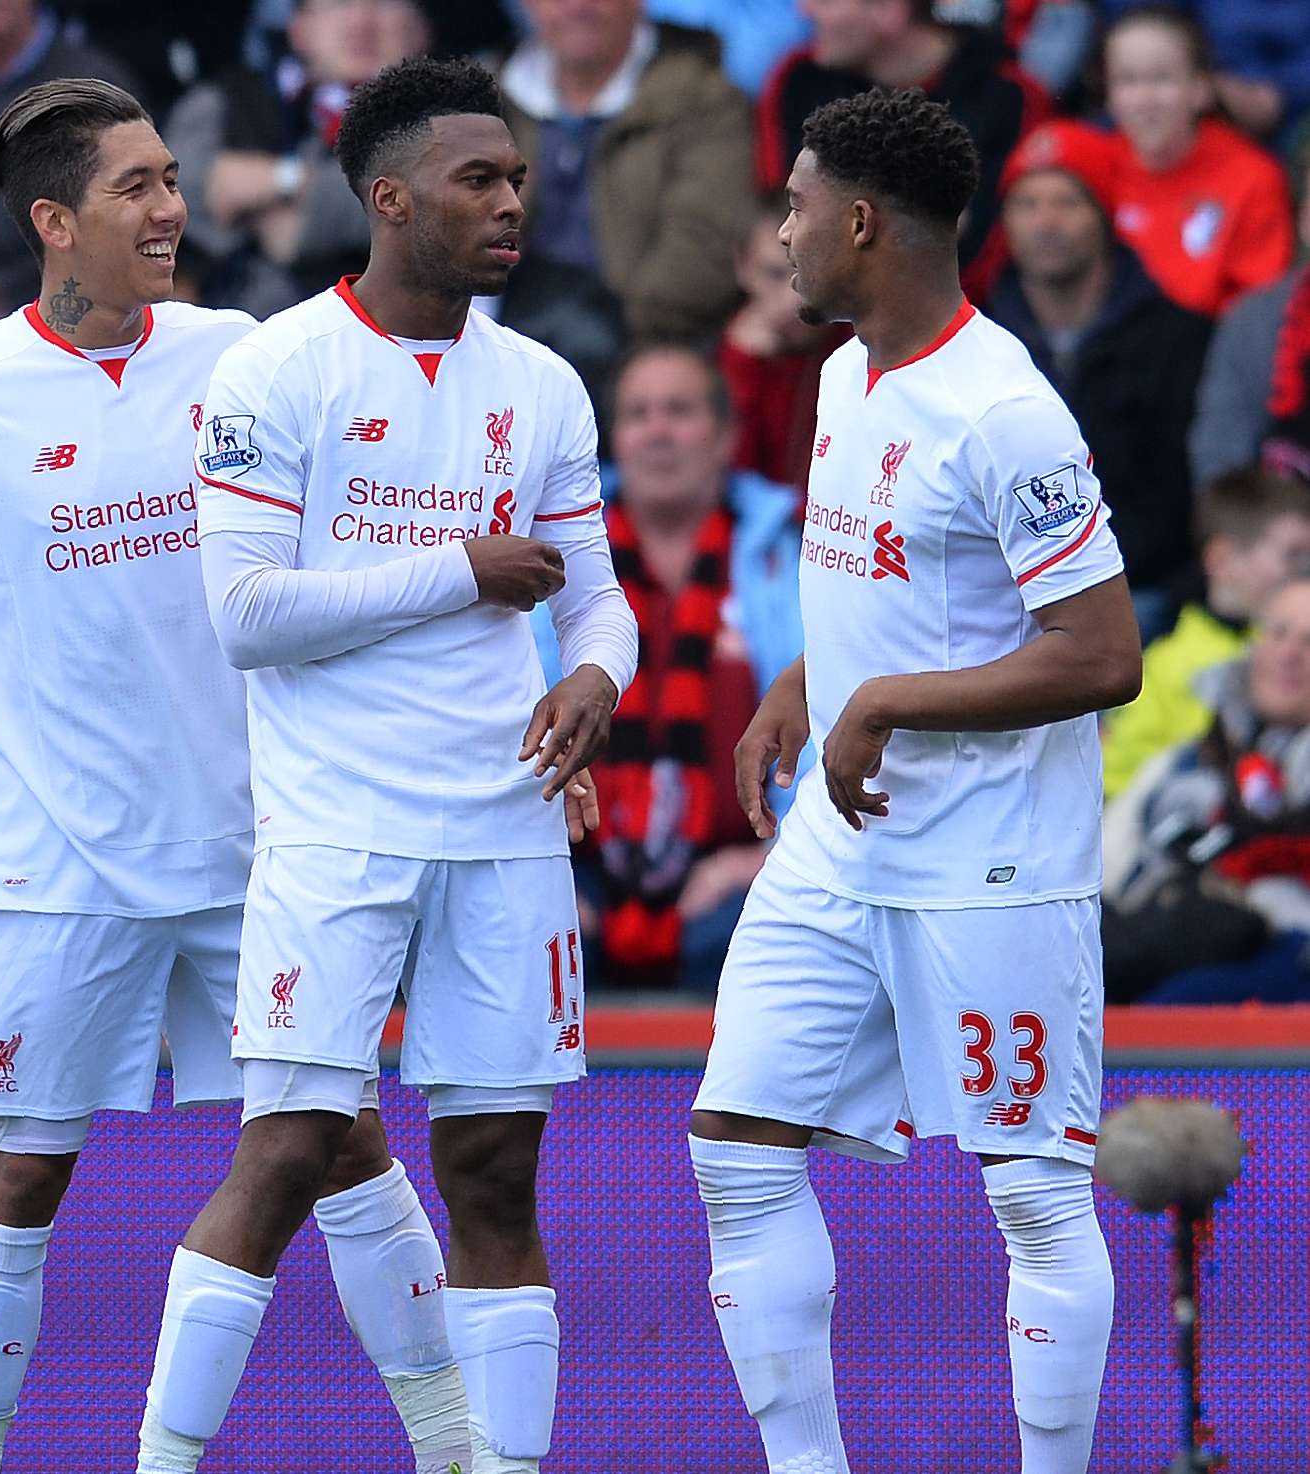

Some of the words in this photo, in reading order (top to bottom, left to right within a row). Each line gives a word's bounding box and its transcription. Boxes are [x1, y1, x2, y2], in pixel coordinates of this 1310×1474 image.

[50, 482, 197, 533] Standard
[347, 478, 483, 513] Standard
[46, 519, 201, 572] Chartered
[958, 1010, 1048, 1099] 33
